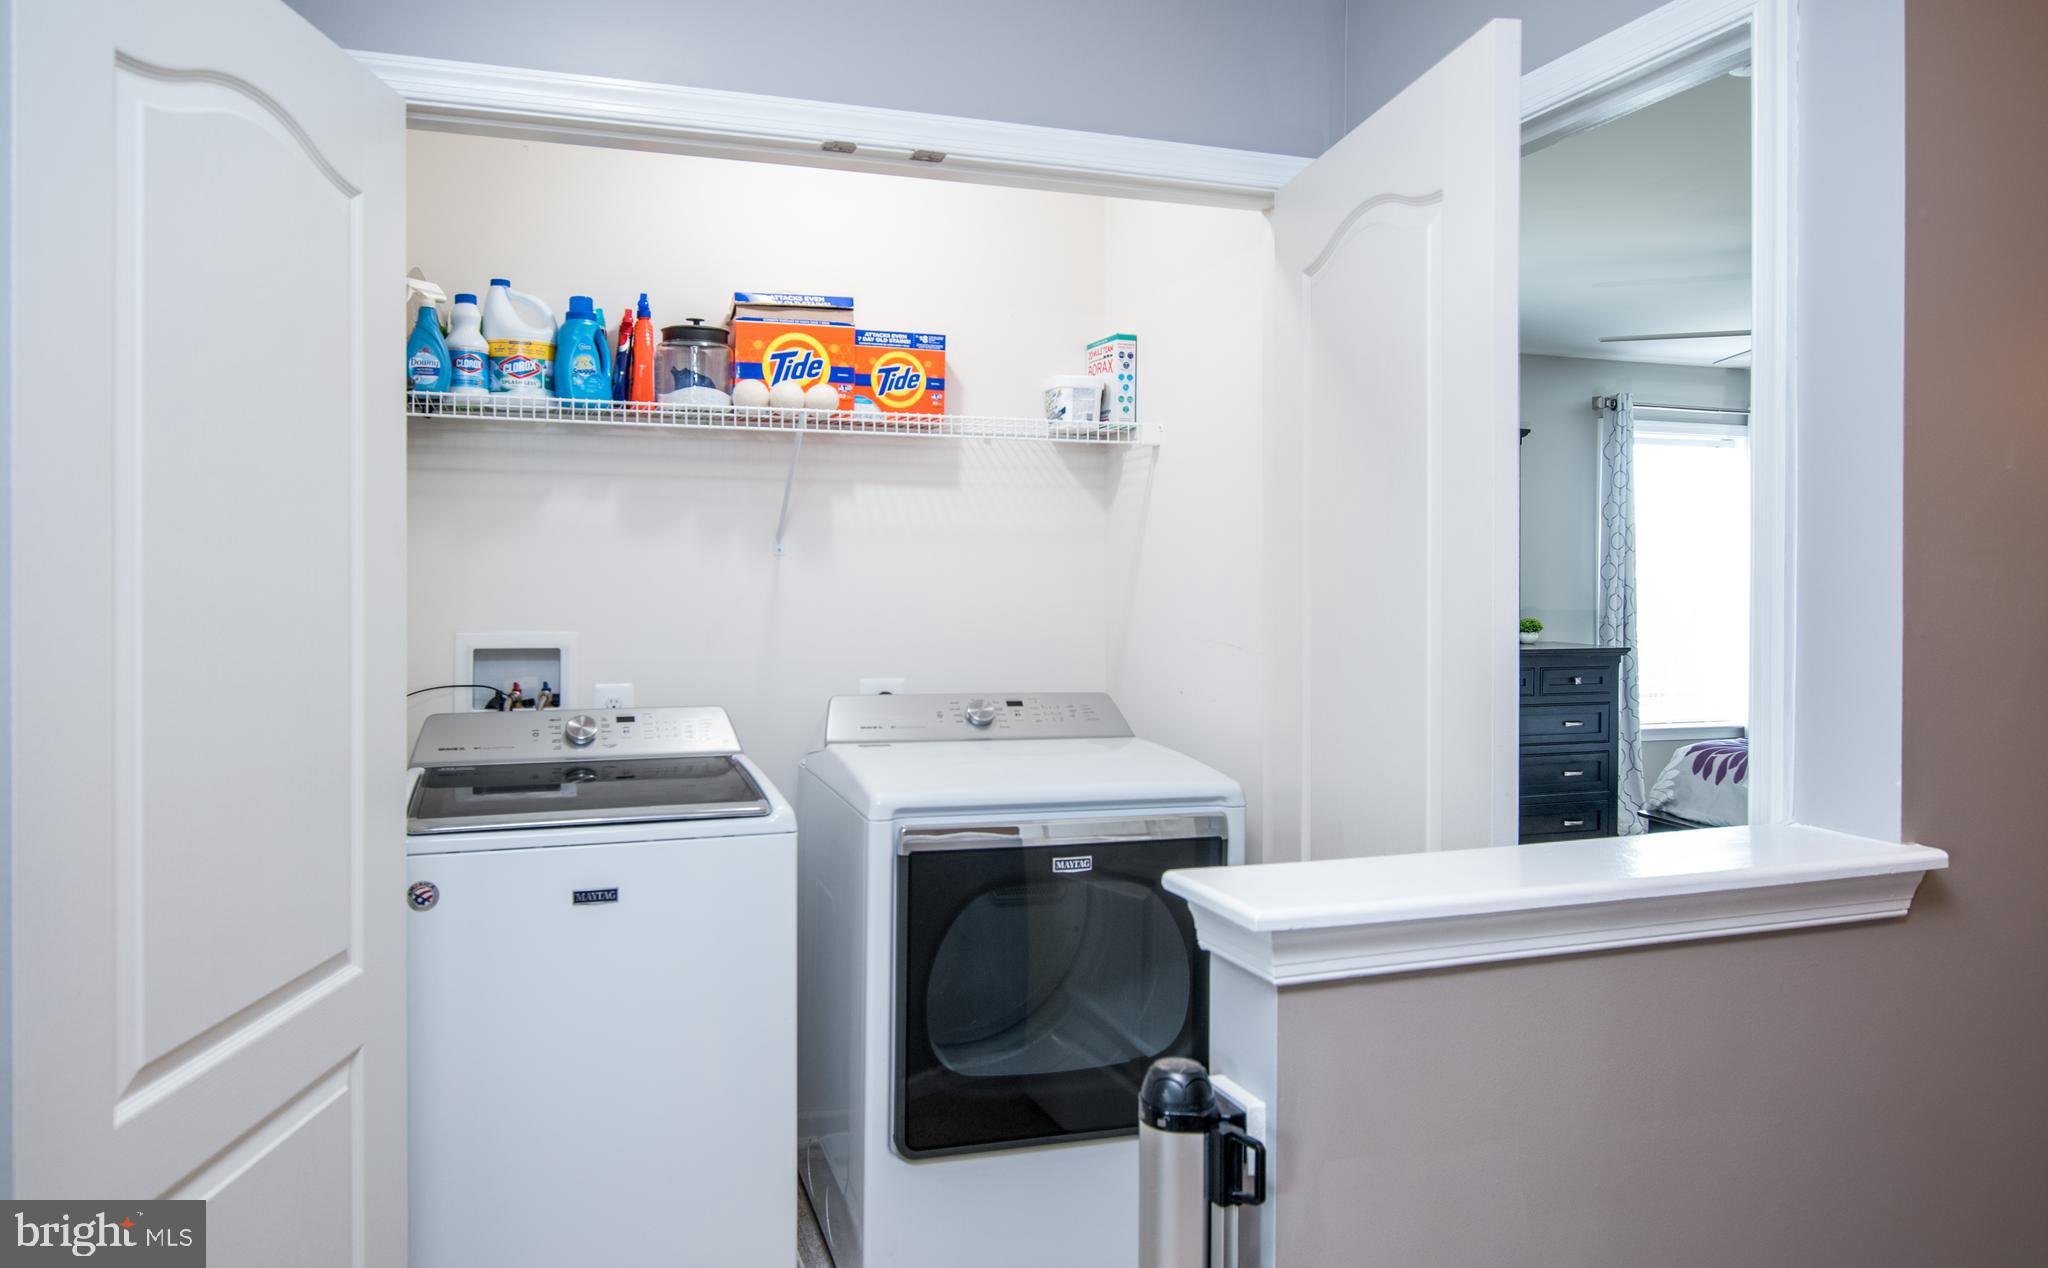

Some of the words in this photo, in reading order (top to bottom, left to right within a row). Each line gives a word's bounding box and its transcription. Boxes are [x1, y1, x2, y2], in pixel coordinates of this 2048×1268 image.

[410, 358, 439, 368] Downy
[456, 358, 482, 369] CLOROX
[503, 359, 537, 374] CLOROX
[769, 350, 824, 387] Tide
[877, 365, 921, 397] Tide
[1055, 860, 1090, 869] MAYTAG
[575, 890, 616, 901] MAYTAG
